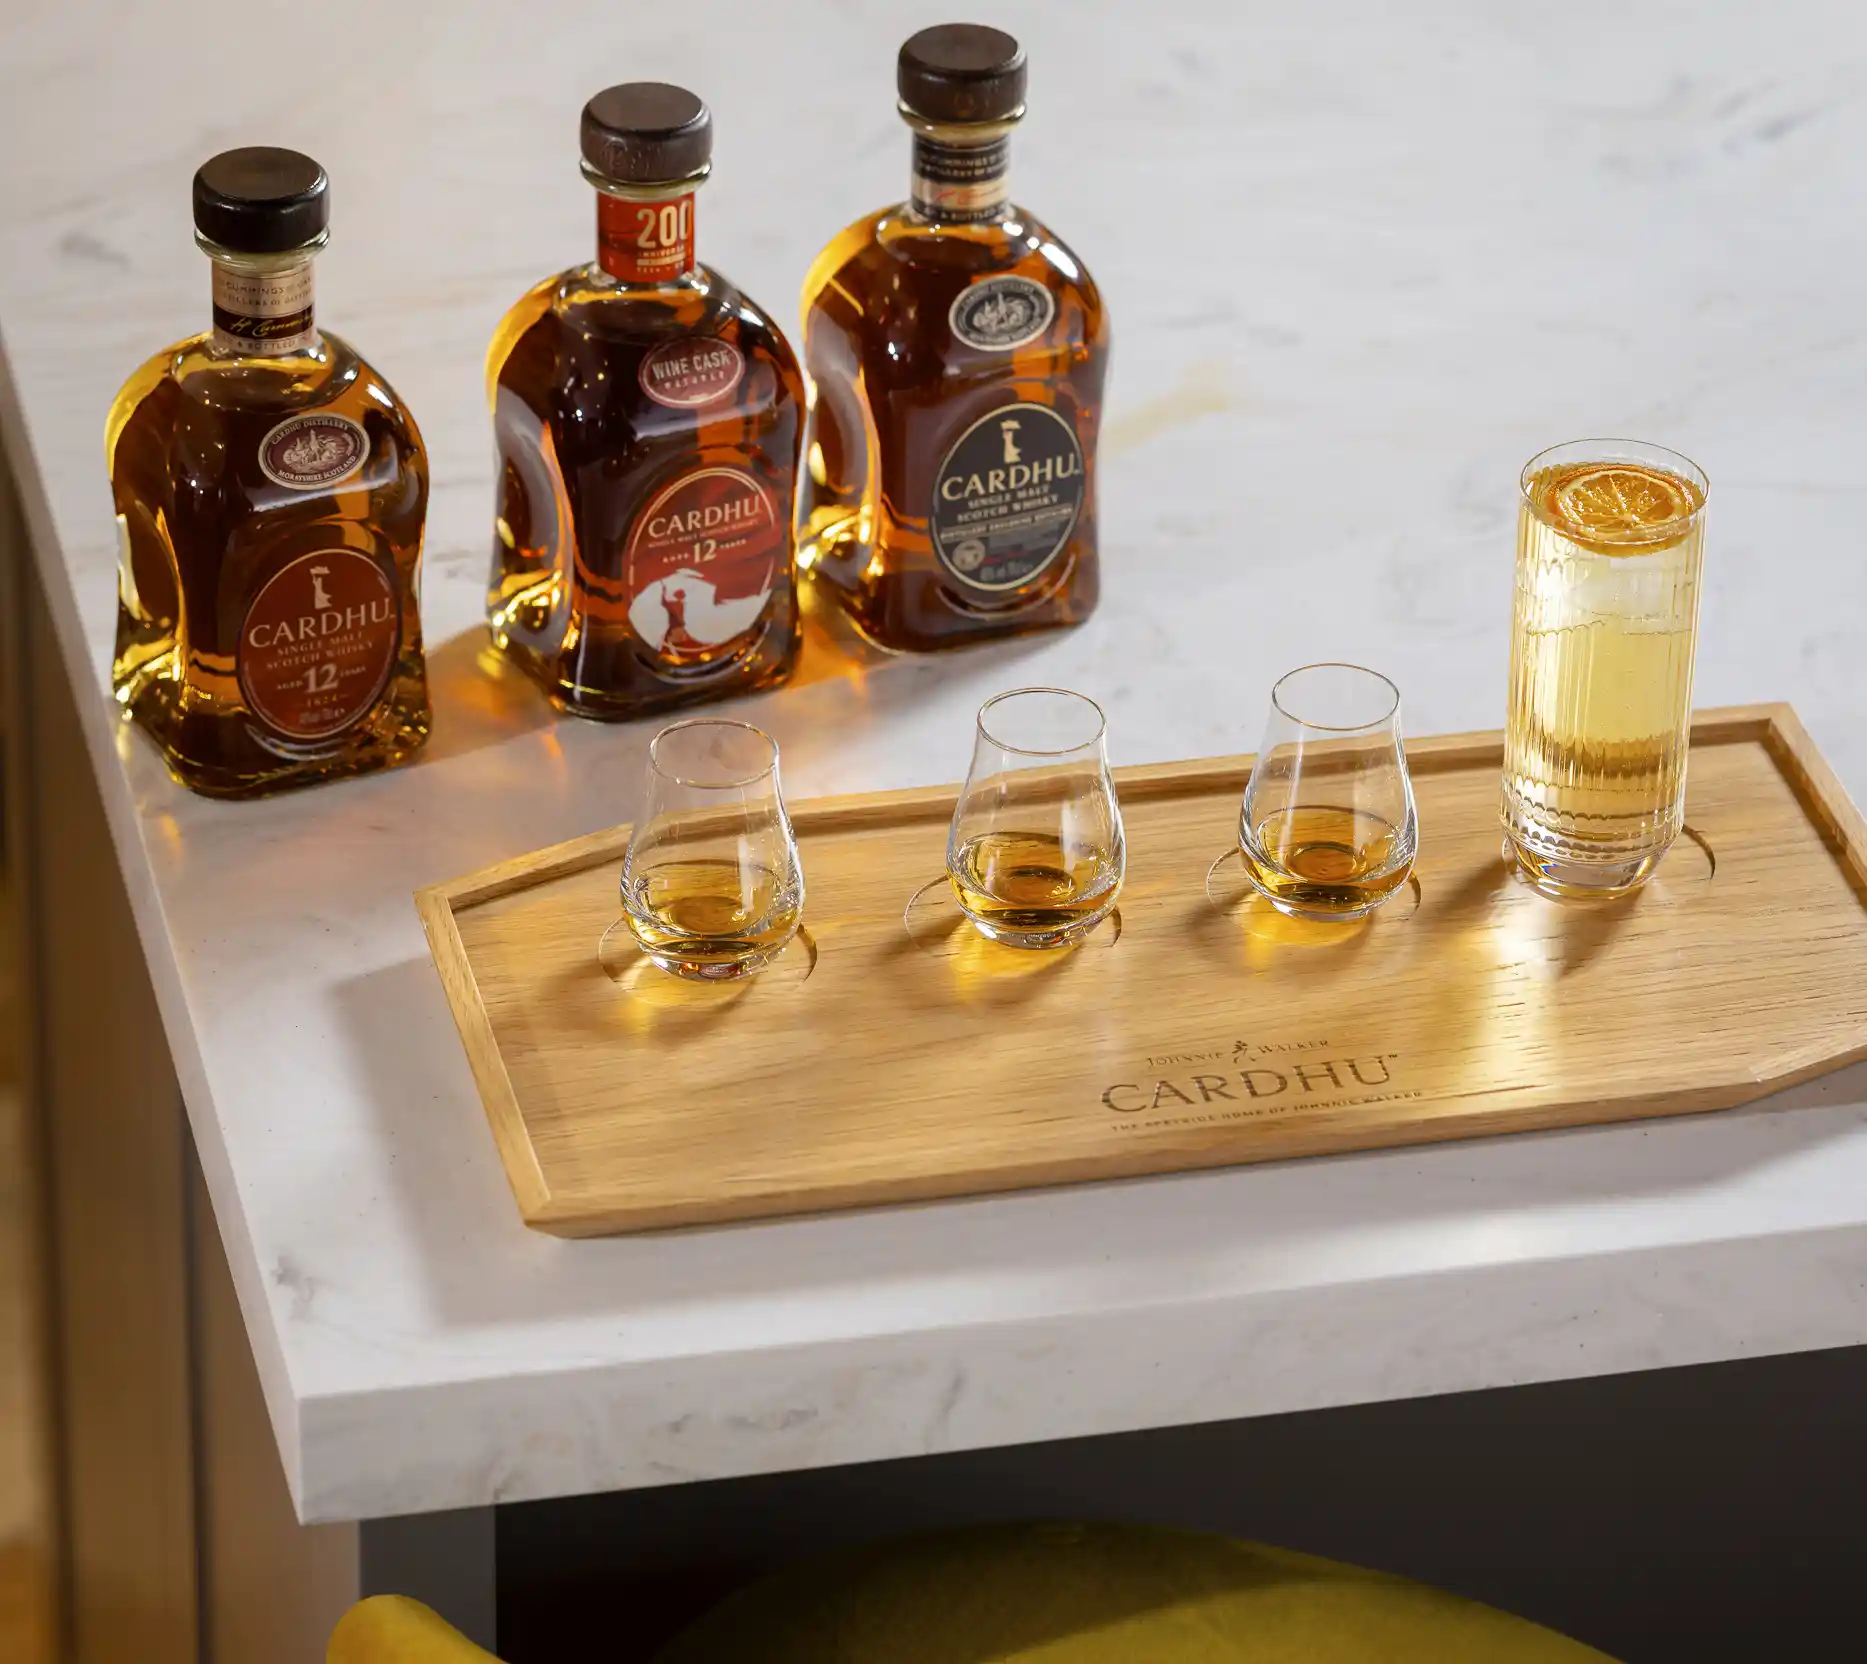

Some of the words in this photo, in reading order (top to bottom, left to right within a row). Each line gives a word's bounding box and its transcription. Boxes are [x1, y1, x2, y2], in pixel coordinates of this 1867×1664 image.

[247, 340, 296, 350] BOTTLED
[651, 357, 690, 380] WINE
[692, 349, 731, 372] CASK
[303, 418, 349, 431] DISTILLERY
[277, 469, 323, 482] MORAYSHIRE
[323, 455, 357, 479] SCOTLAND
[941, 452, 1077, 501] CARDHU
[648, 495, 761, 539] CARDHU
[693, 538, 718, 565] 12
[249, 597, 391, 649] CARDHU
[266, 653, 320, 670] SCOTCH
[325, 639, 374, 658] WHISKY
[276, 640, 323, 657] SINGLE
[329, 631, 364, 646] MALT
[303, 663, 340, 694] 12
[1146, 1051, 1224, 1068] JOHNNIE
[1257, 1039, 1330, 1054] WALKER
